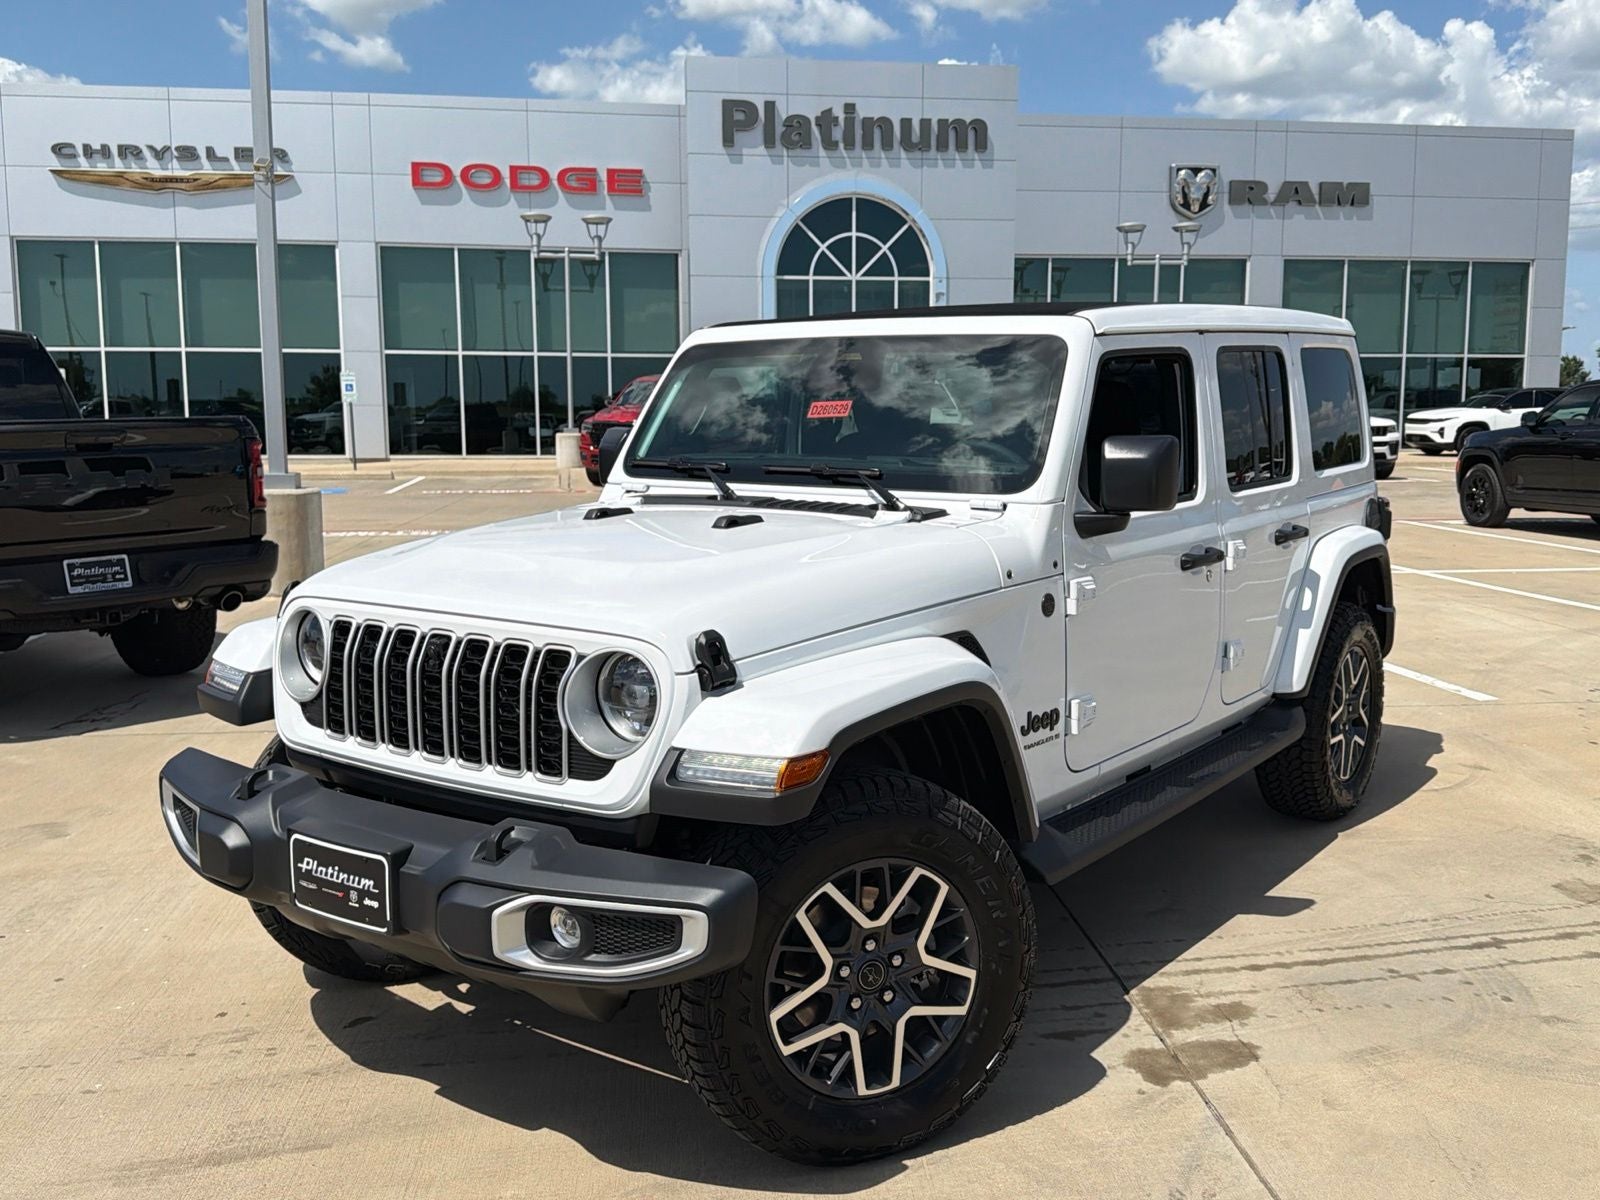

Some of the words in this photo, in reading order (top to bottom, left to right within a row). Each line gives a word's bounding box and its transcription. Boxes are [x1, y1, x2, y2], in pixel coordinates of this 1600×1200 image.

[721, 98, 989, 153] Platinum
[50, 142, 290, 163] CHRYSLER
[411, 161, 644, 197] DODGE
[1228, 180, 1371, 207] RAM
[70, 566, 124, 577] Platinum
[1020, 707, 1060, 737] Jeep
[297, 856, 379, 893] Platinum
[363, 896, 379, 909] Jeep
